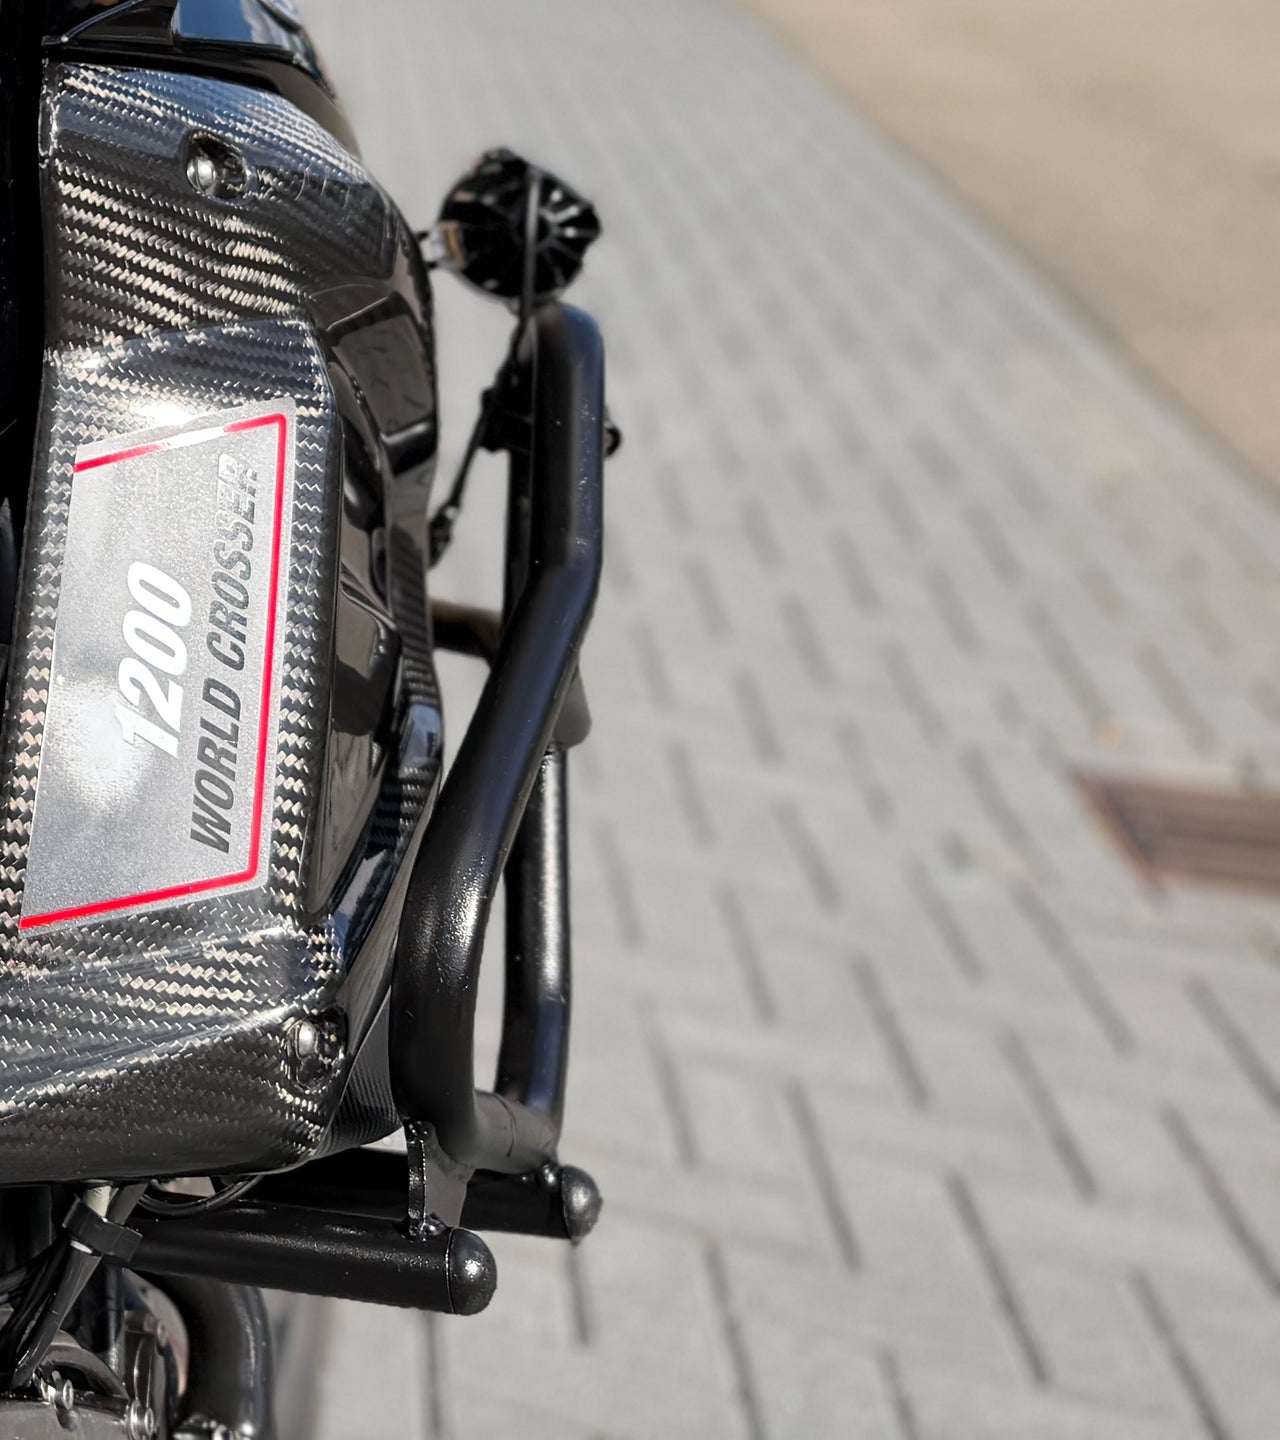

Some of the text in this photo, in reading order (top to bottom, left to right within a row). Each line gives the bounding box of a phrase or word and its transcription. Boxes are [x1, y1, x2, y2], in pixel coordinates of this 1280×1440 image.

[115, 561, 192, 758] 1200
[190, 453, 258, 854] WORLD CROSSER
